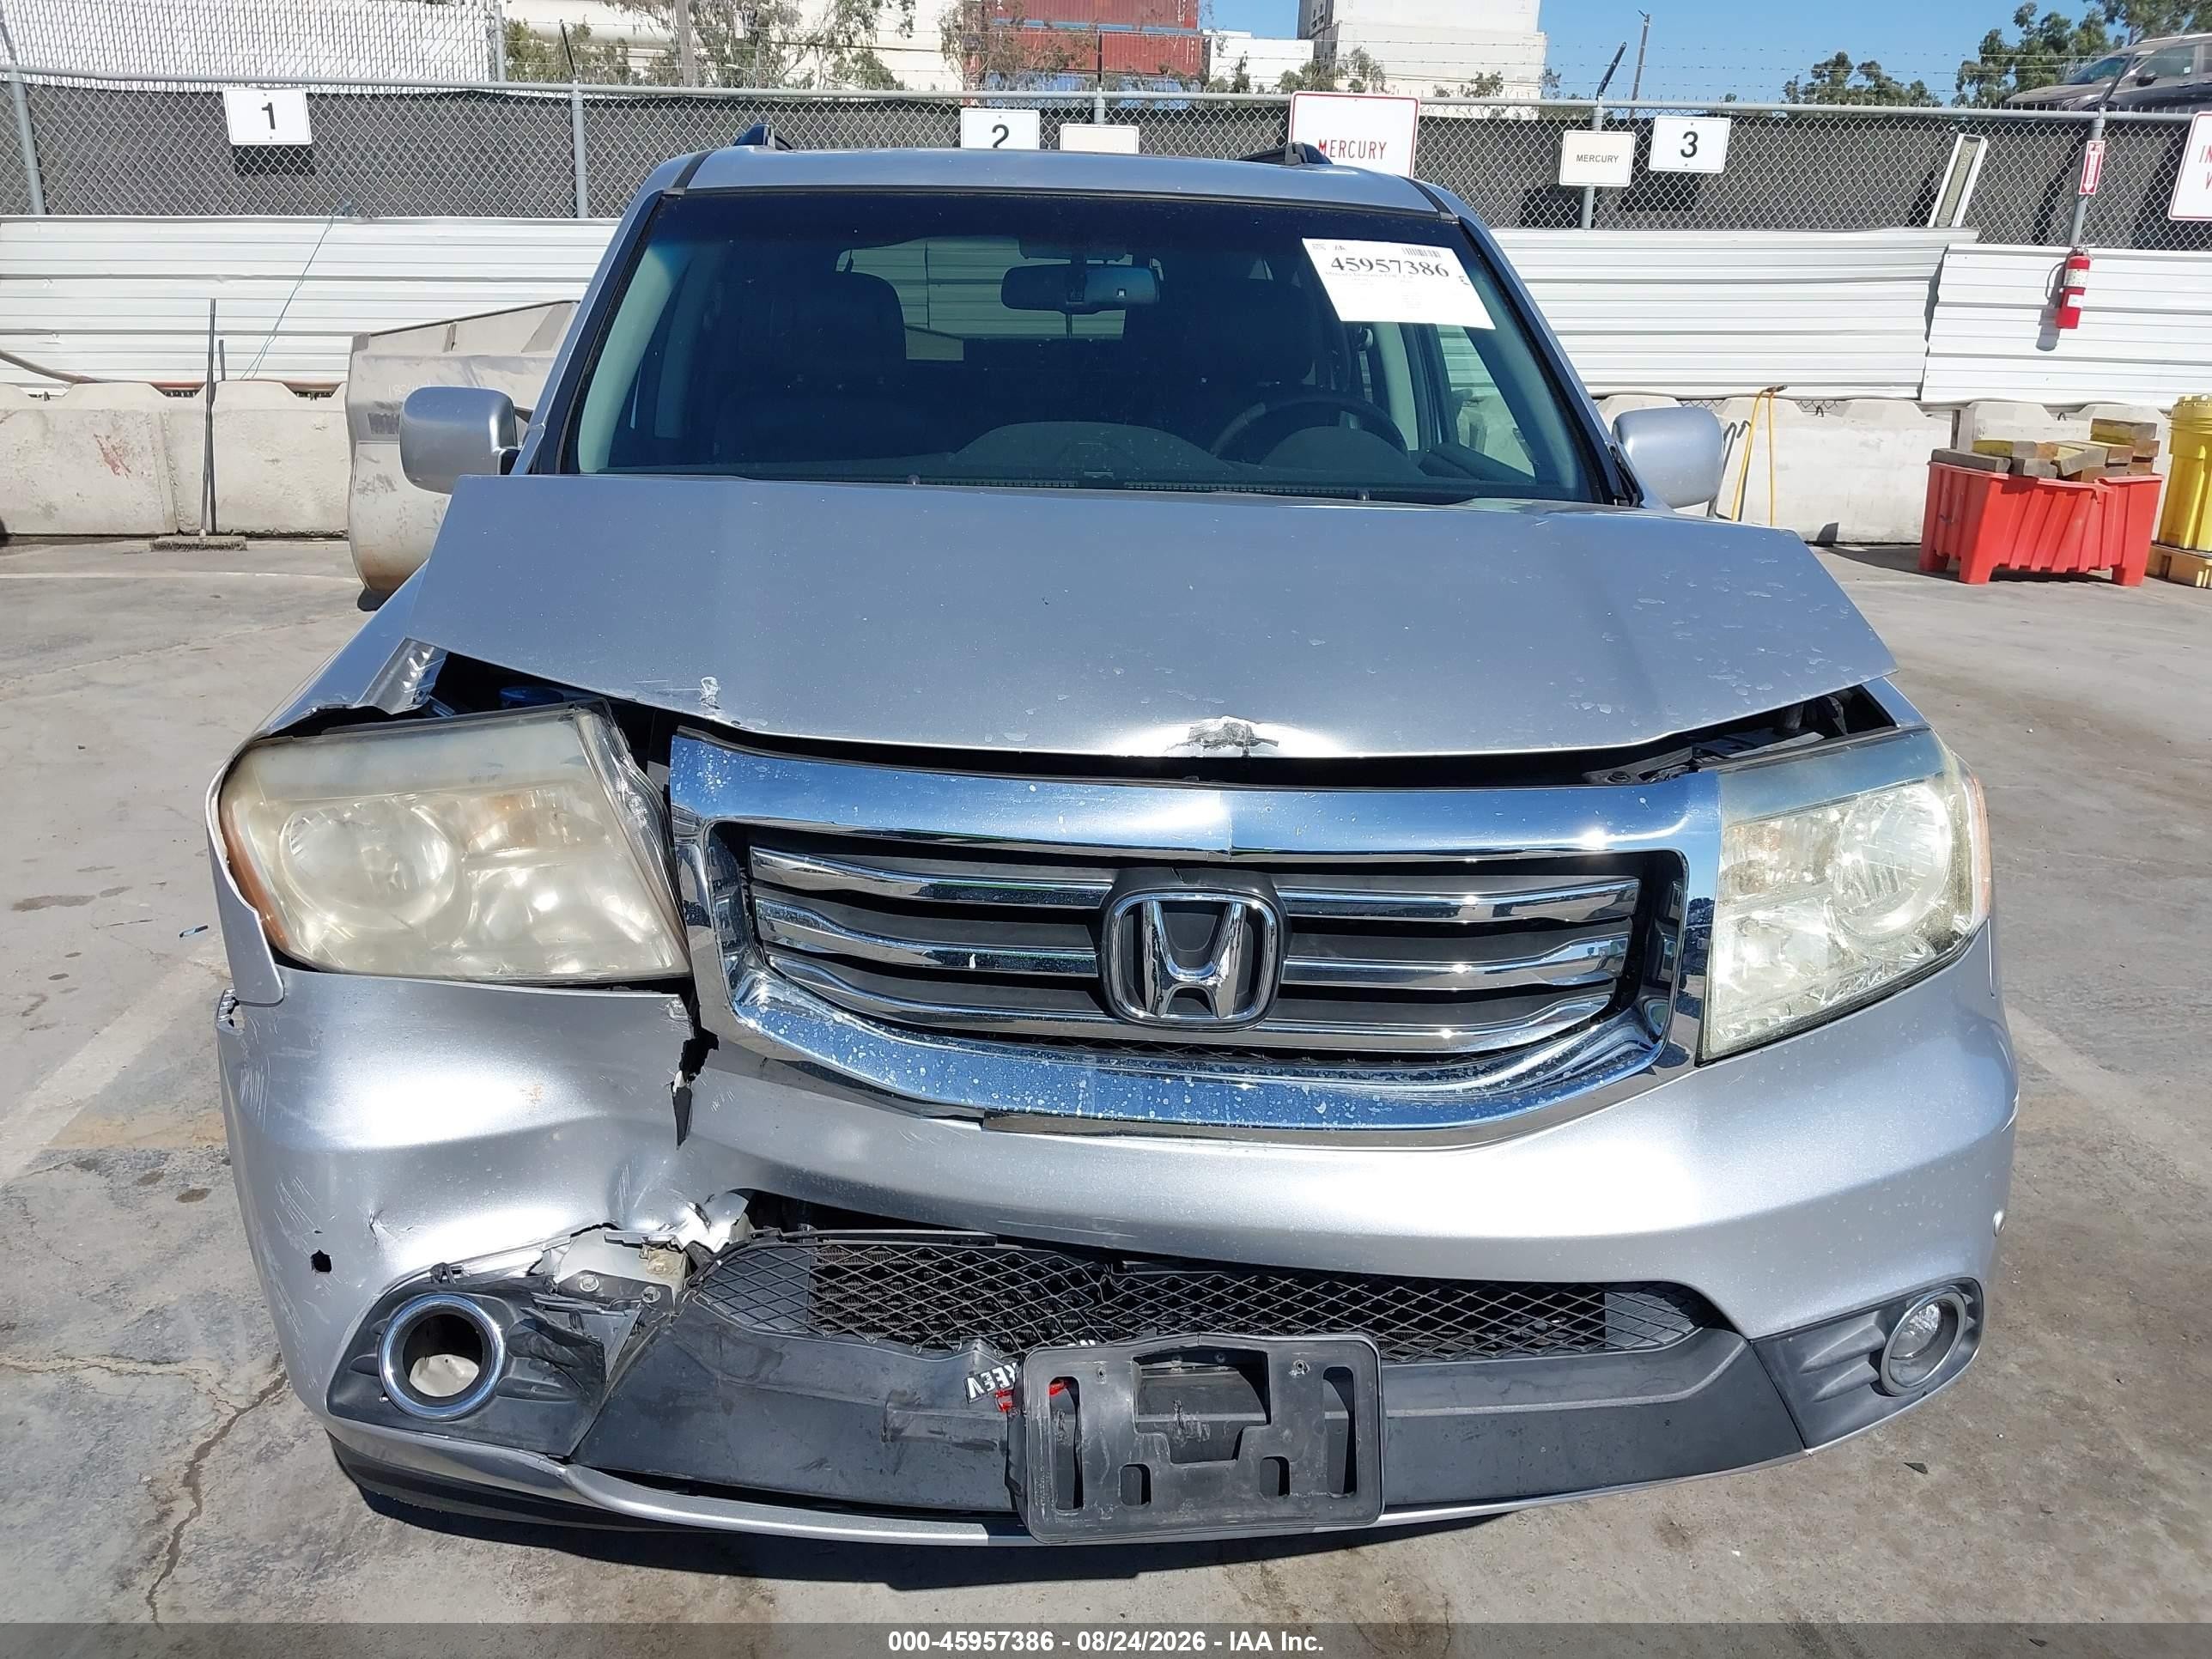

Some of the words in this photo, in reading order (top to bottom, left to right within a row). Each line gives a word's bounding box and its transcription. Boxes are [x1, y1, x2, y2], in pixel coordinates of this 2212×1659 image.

[260, 101, 276, 131] 1
[991, 123, 1010, 149] 2
[1680, 131, 1698, 158] 3
[1318, 138, 1388, 160] MERCURY
[1576, 154, 1620, 163] MERCURY
[1330, 257, 1449, 277] 45957386
